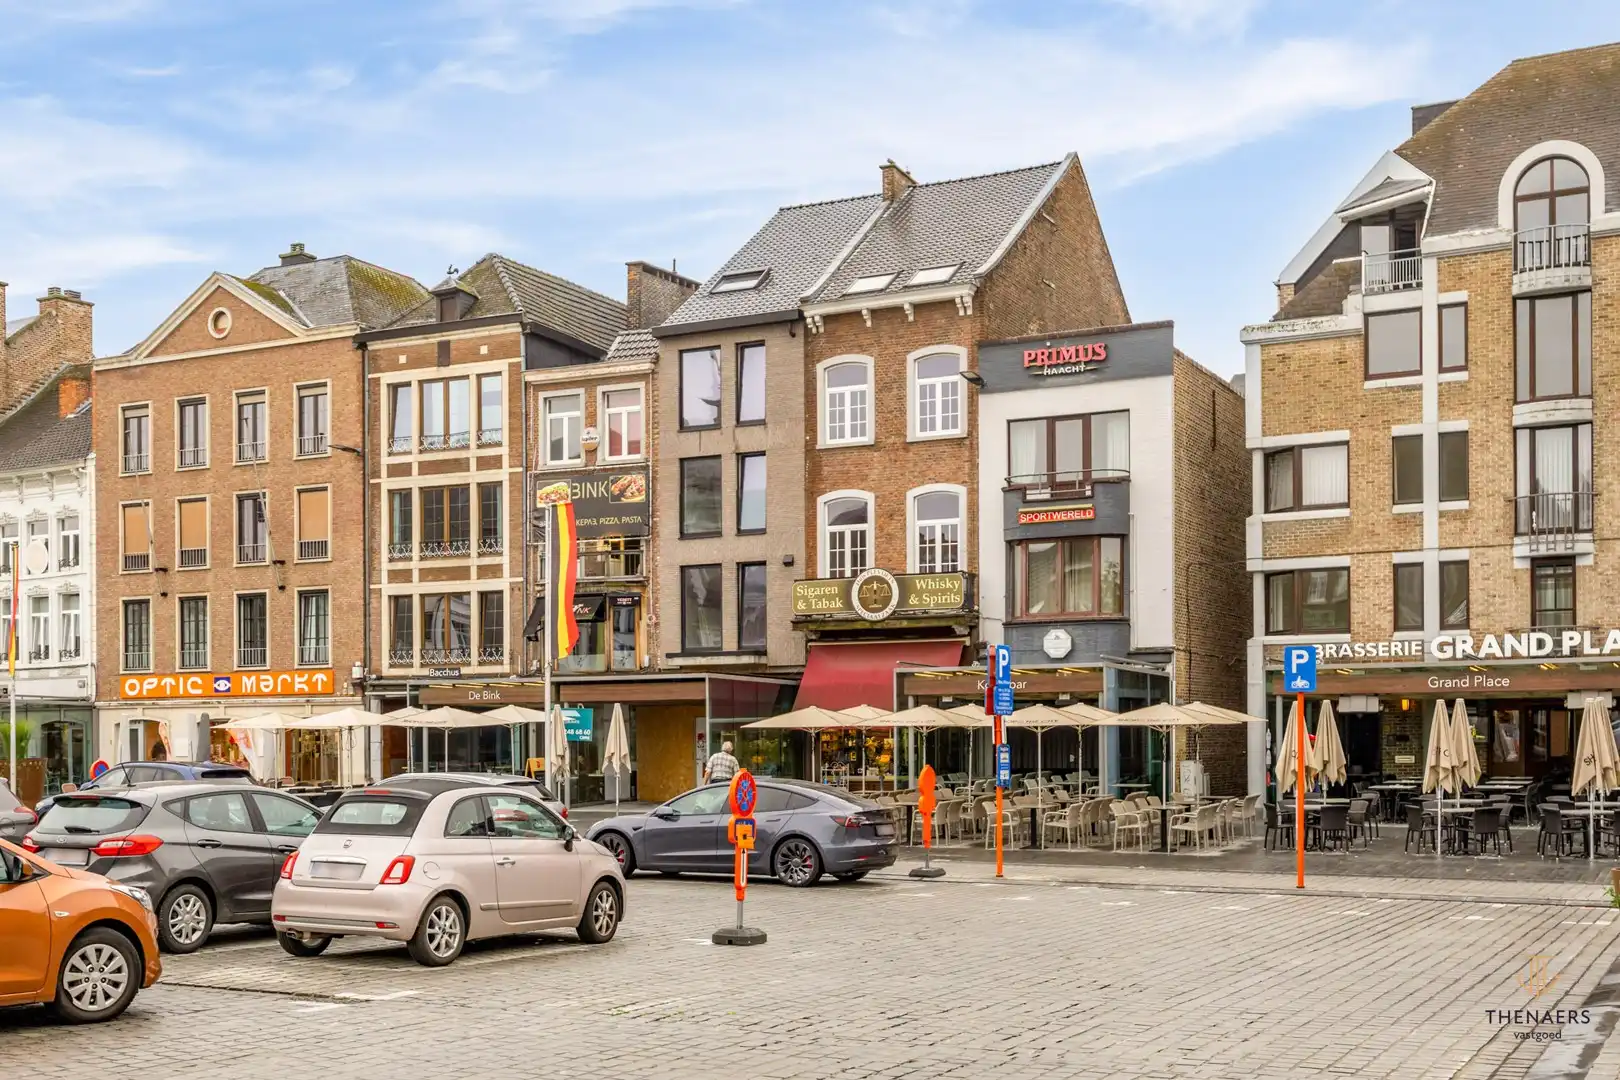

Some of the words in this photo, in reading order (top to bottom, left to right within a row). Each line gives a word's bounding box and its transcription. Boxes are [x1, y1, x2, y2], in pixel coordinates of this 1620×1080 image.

[1024, 343, 1107, 367] PRIMUS
[1044, 366, 1085, 375] HAACHT
[572, 481, 608, 498] BINK
[1020, 509, 1094, 522] SPORTWERELD
[916, 577, 960, 591] Whisky
[797, 585, 838, 598] Sigaren
[797, 600, 806, 610] &
[809, 598, 844, 609] Tabak
[909, 594, 920, 604] &
[922, 593, 960, 606] Spirits
[1312, 641, 1423, 659] BRASSERIE
[1430, 631, 1555, 659] GRAND
[999, 648, 1009, 678] P
[1291, 650, 1309, 674] P
[429, 668, 460, 677] Bacchus
[124, 676, 203, 696] OPTIC
[1428, 676, 1469, 689] Grand
[1474, 675, 1510, 687] Place
[469, 691, 481, 700] De
[483, 690, 501, 700] Bink
